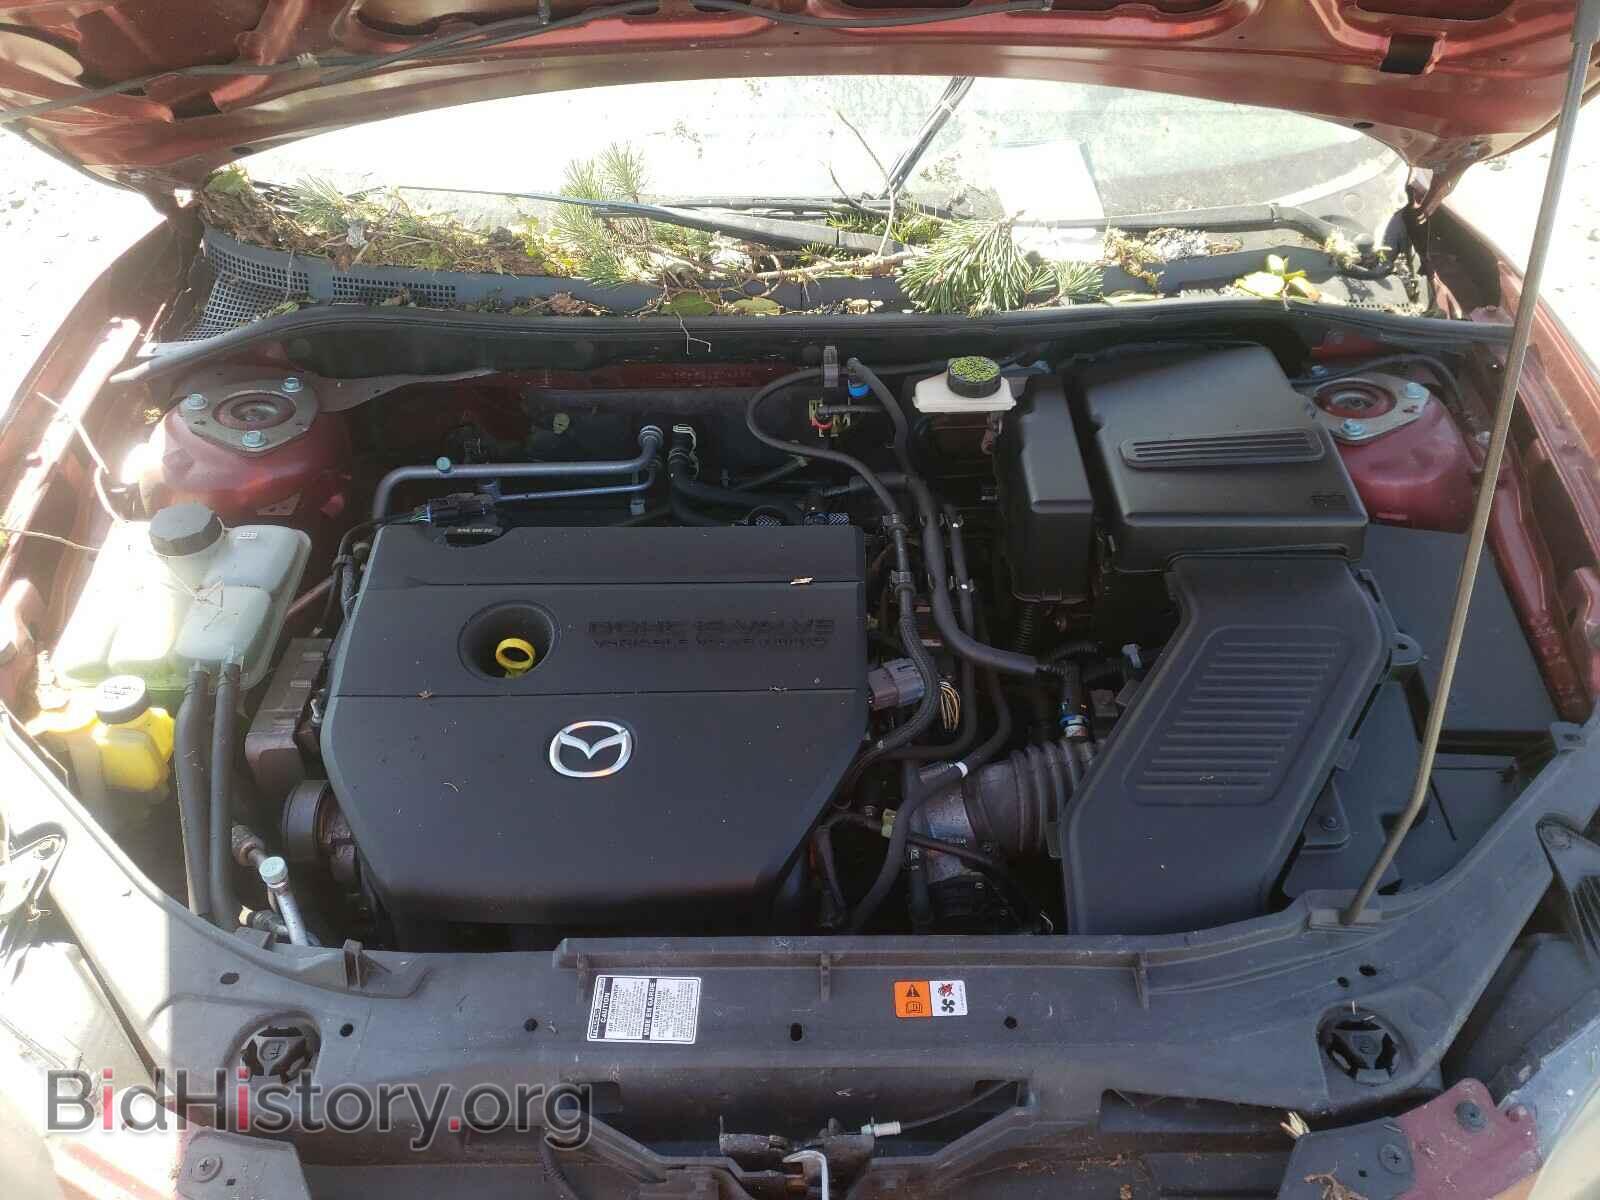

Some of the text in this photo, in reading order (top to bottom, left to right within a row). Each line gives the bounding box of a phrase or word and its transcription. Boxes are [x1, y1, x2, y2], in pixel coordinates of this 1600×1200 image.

[647, 982, 656, 1007] GARDE
[600, 992, 611, 1023] CAUTION
[646, 1007, 653, 1018] EN
